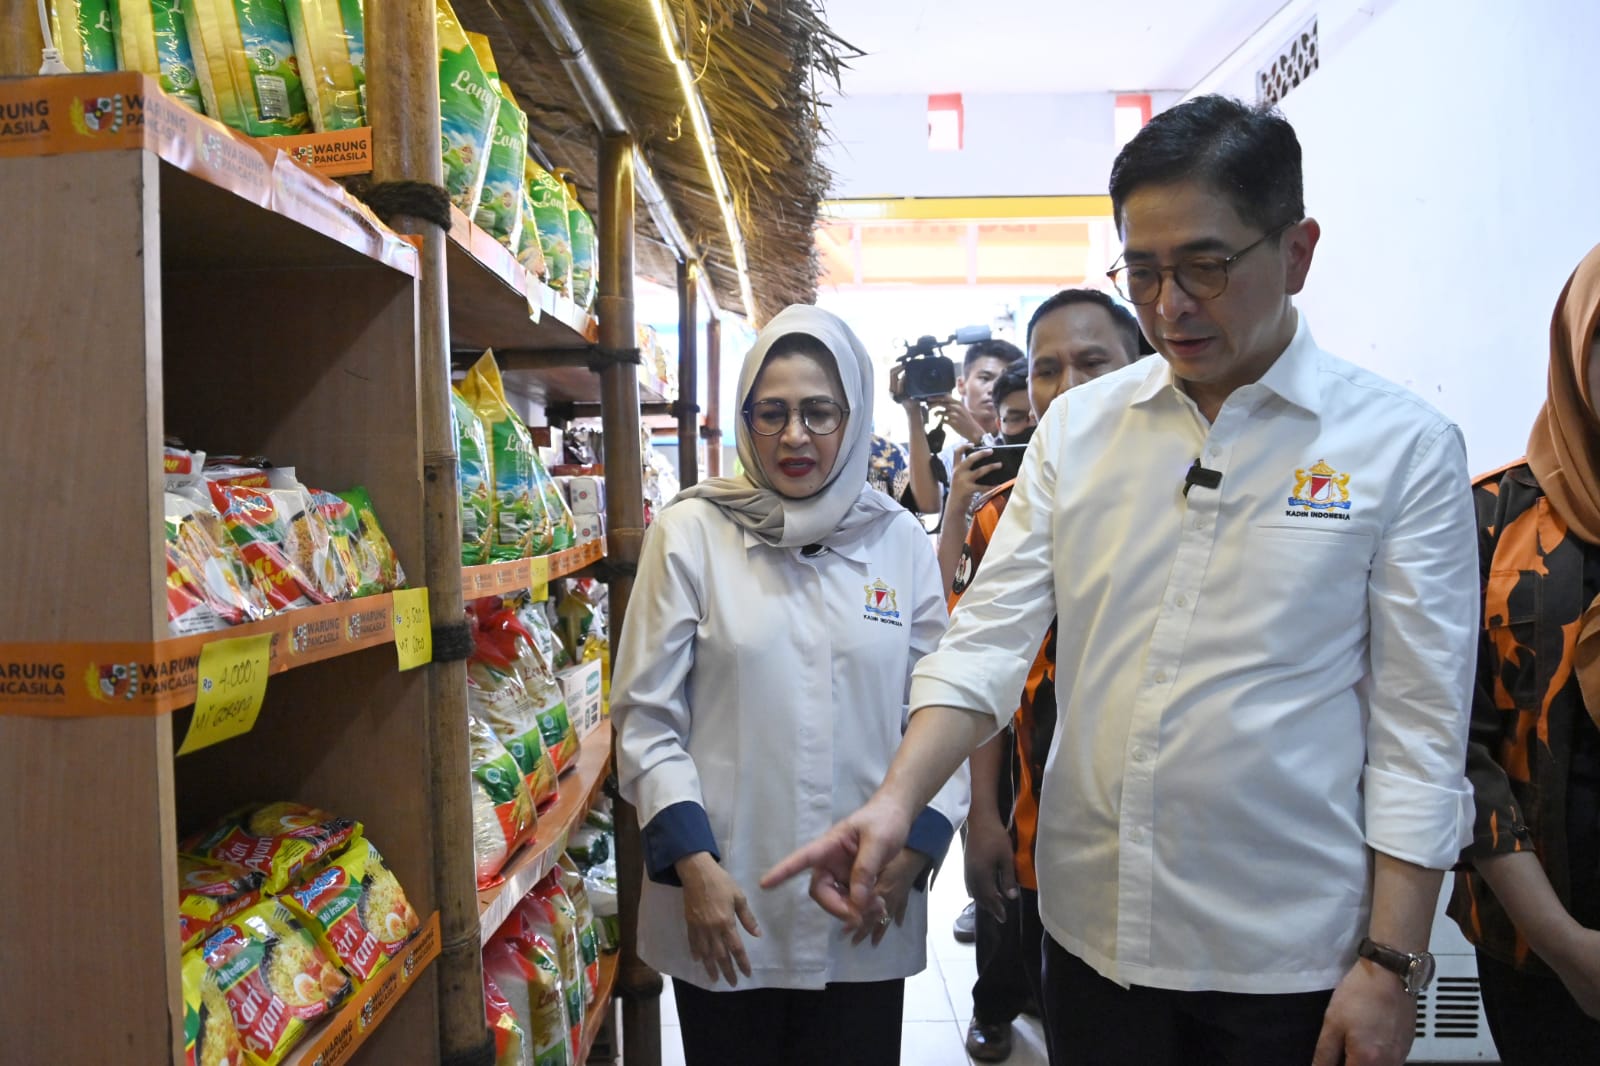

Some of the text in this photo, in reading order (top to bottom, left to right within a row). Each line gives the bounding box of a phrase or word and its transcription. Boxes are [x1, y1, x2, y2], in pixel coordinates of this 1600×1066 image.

[0, 118, 50, 136] ASILA
[314, 140, 367, 154] WARUNG
[314, 151, 367, 164] PANCASILA
[1286, 510, 1350, 520] KADIN INDONESIA
[306, 618, 340, 632] WARUNG
[141, 656, 200, 679] WARUN
[141, 676, 198, 696] PANCASIL
[202, 678, 212, 691] Rp
